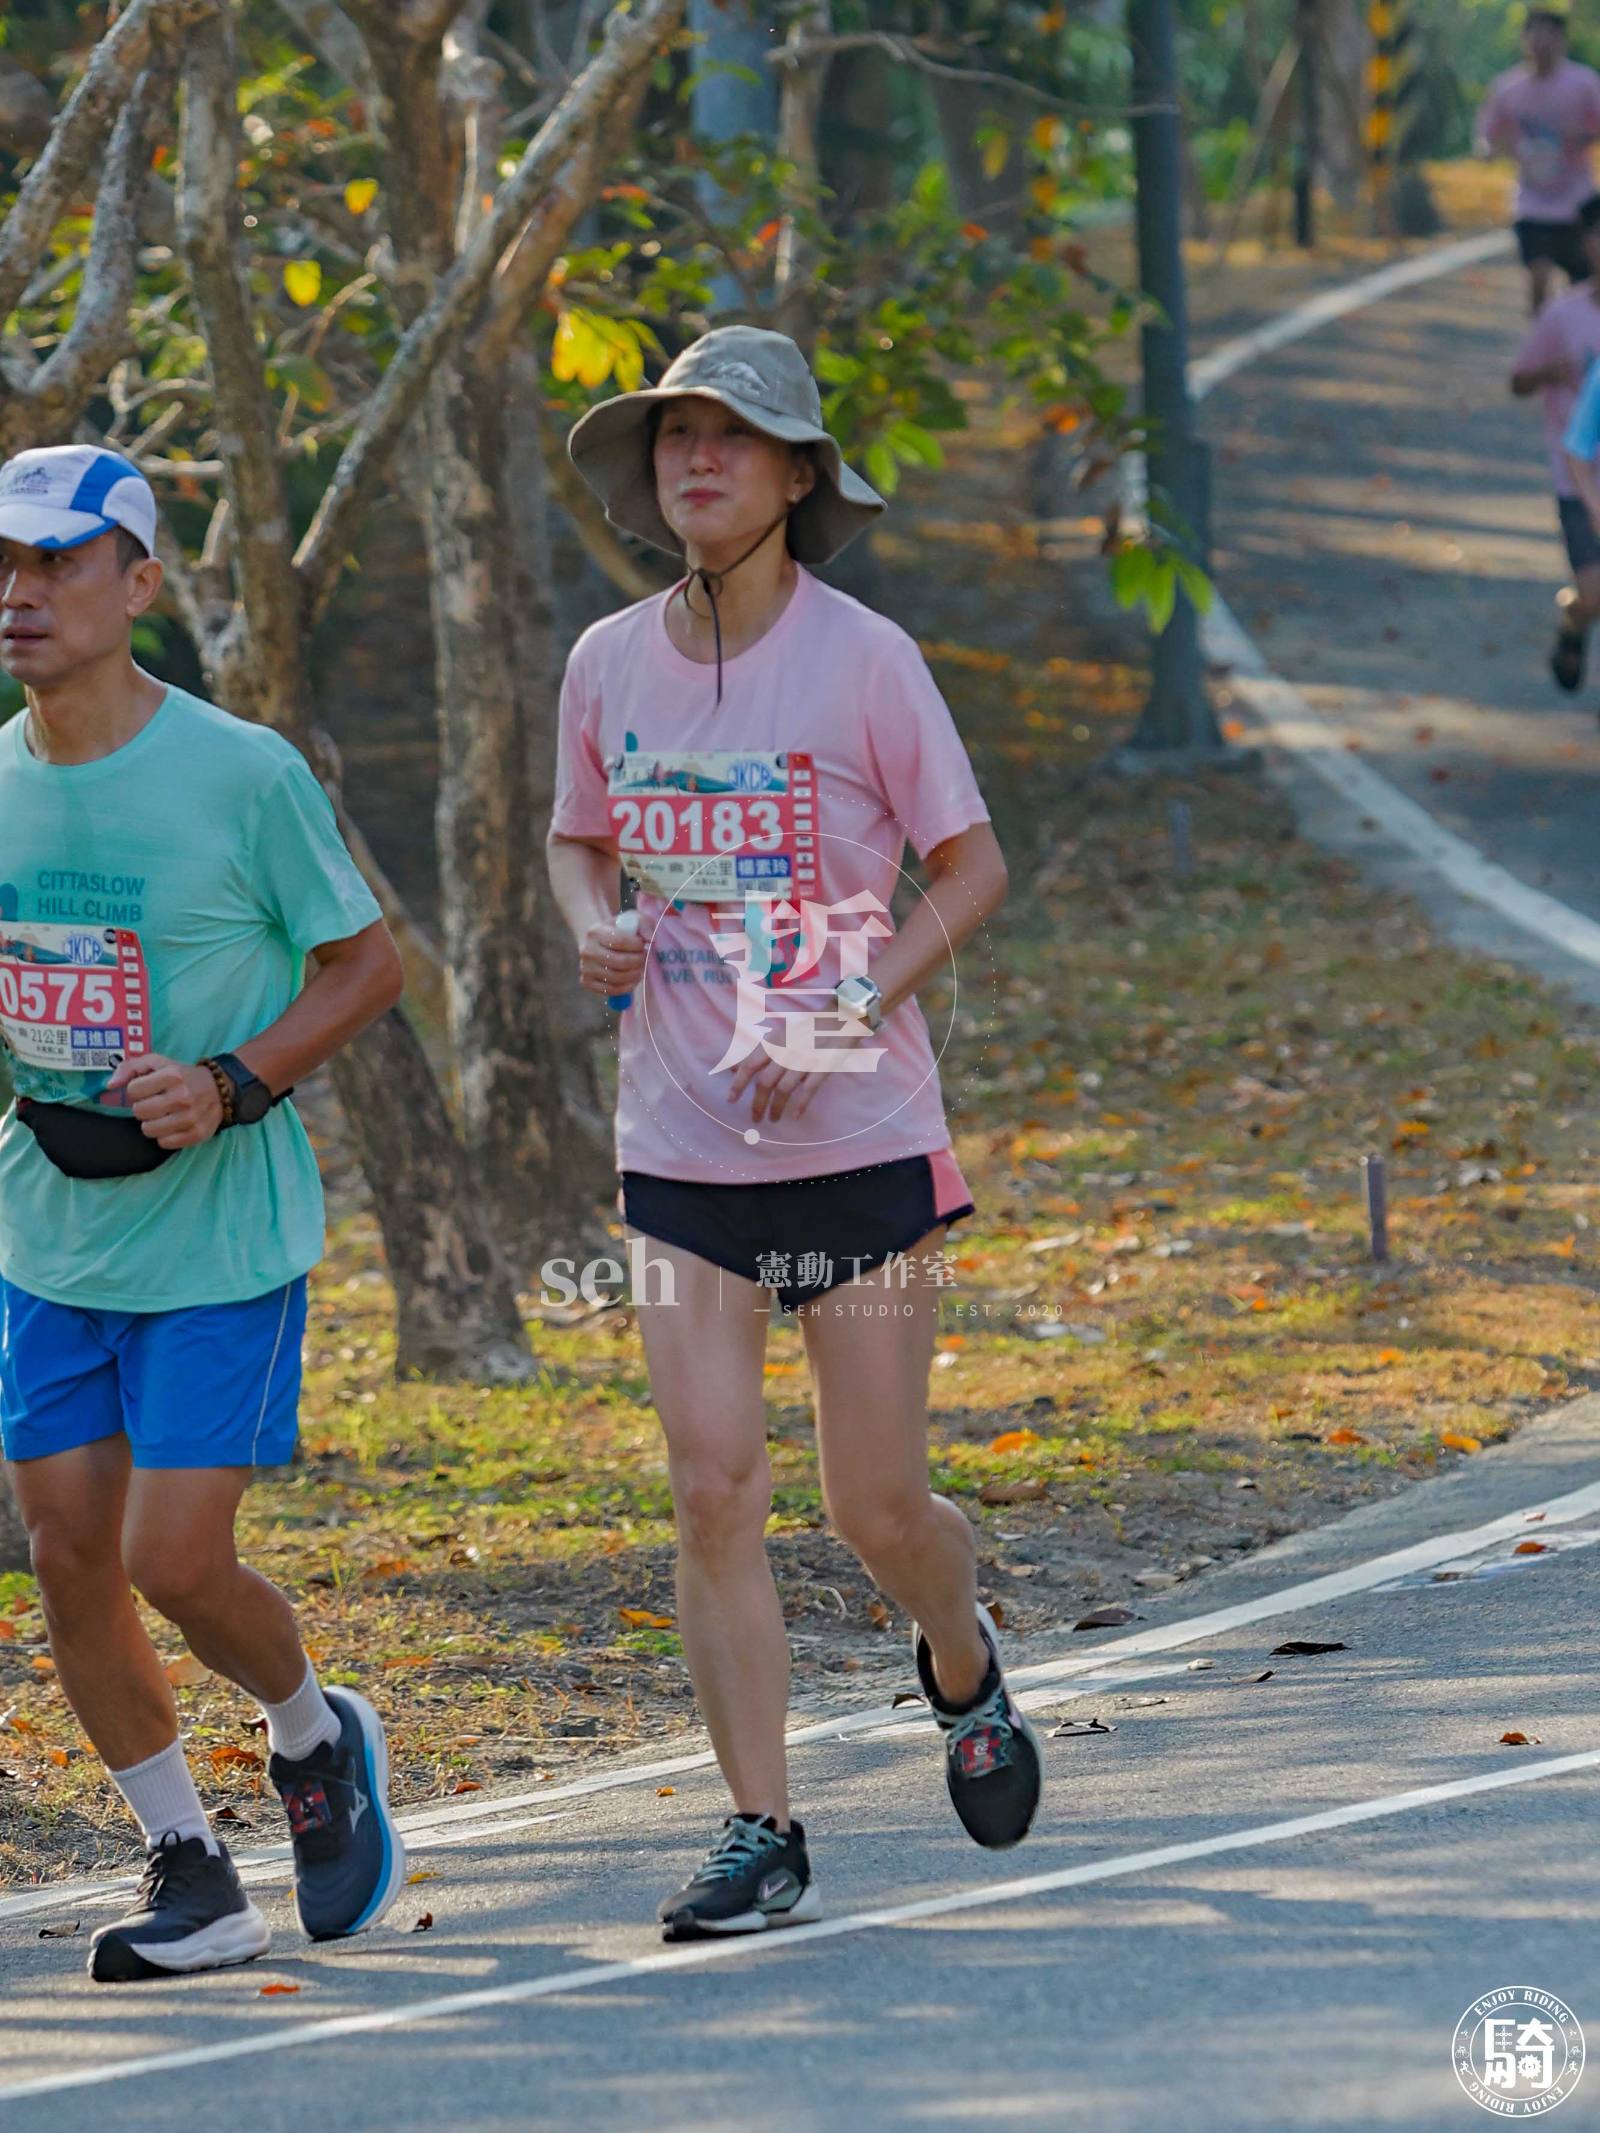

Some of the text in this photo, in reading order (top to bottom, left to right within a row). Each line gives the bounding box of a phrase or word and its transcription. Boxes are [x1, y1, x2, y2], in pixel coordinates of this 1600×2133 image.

[611, 800, 784, 851] 20183
[37, 870, 146, 896] CITTASLOW
[38, 896, 143, 922] HILL CLIMB
[30, 1028, 68, 1045] 21公里
